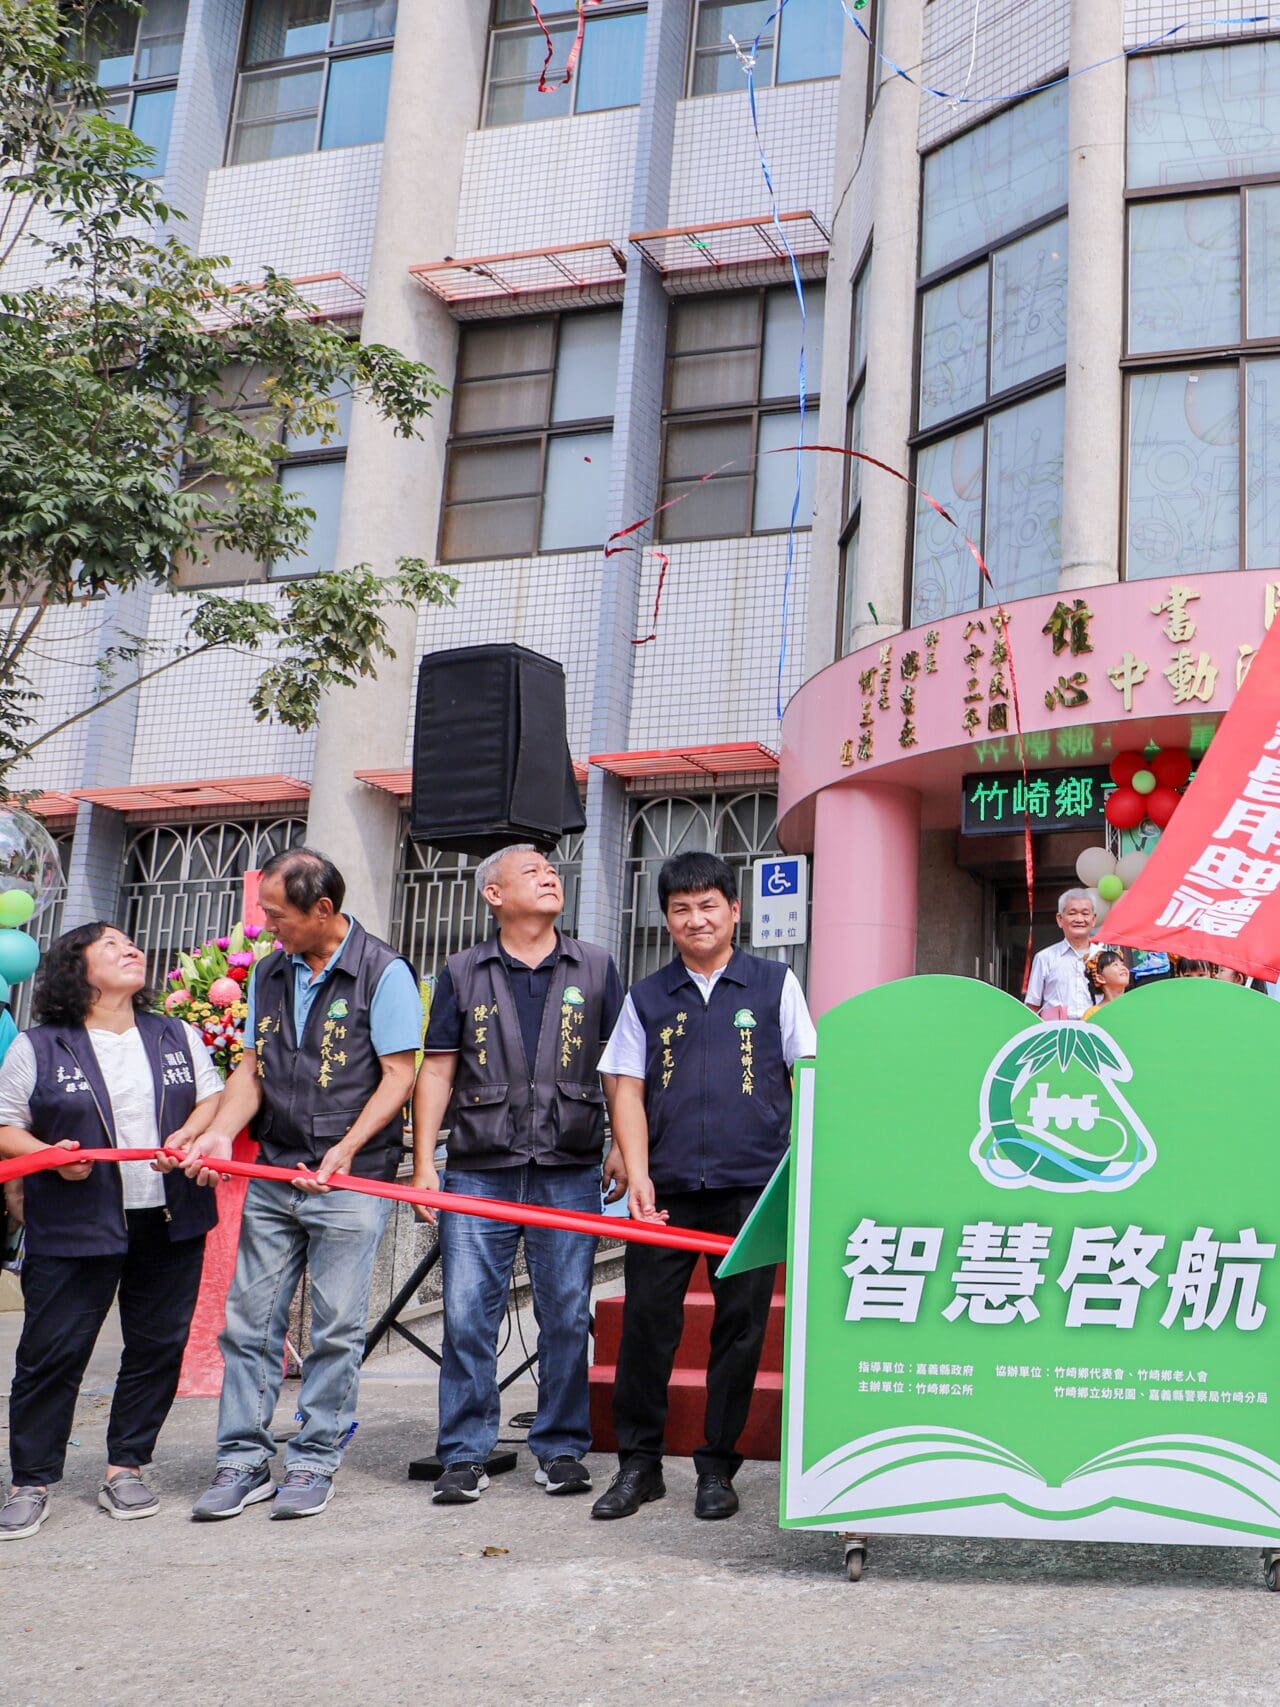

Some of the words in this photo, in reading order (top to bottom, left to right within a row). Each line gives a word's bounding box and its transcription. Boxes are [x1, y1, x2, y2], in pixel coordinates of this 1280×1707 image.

[971, 776, 1117, 822] 竹崎鄉
[761, 911, 798, 924] 專用
[761, 927, 797, 939] 停車位
[858, 1361, 974, 1377] 指導單位：嘉義縣政府
[858, 1380, 974, 1396] 主辦單位：竹崎鄉公所
